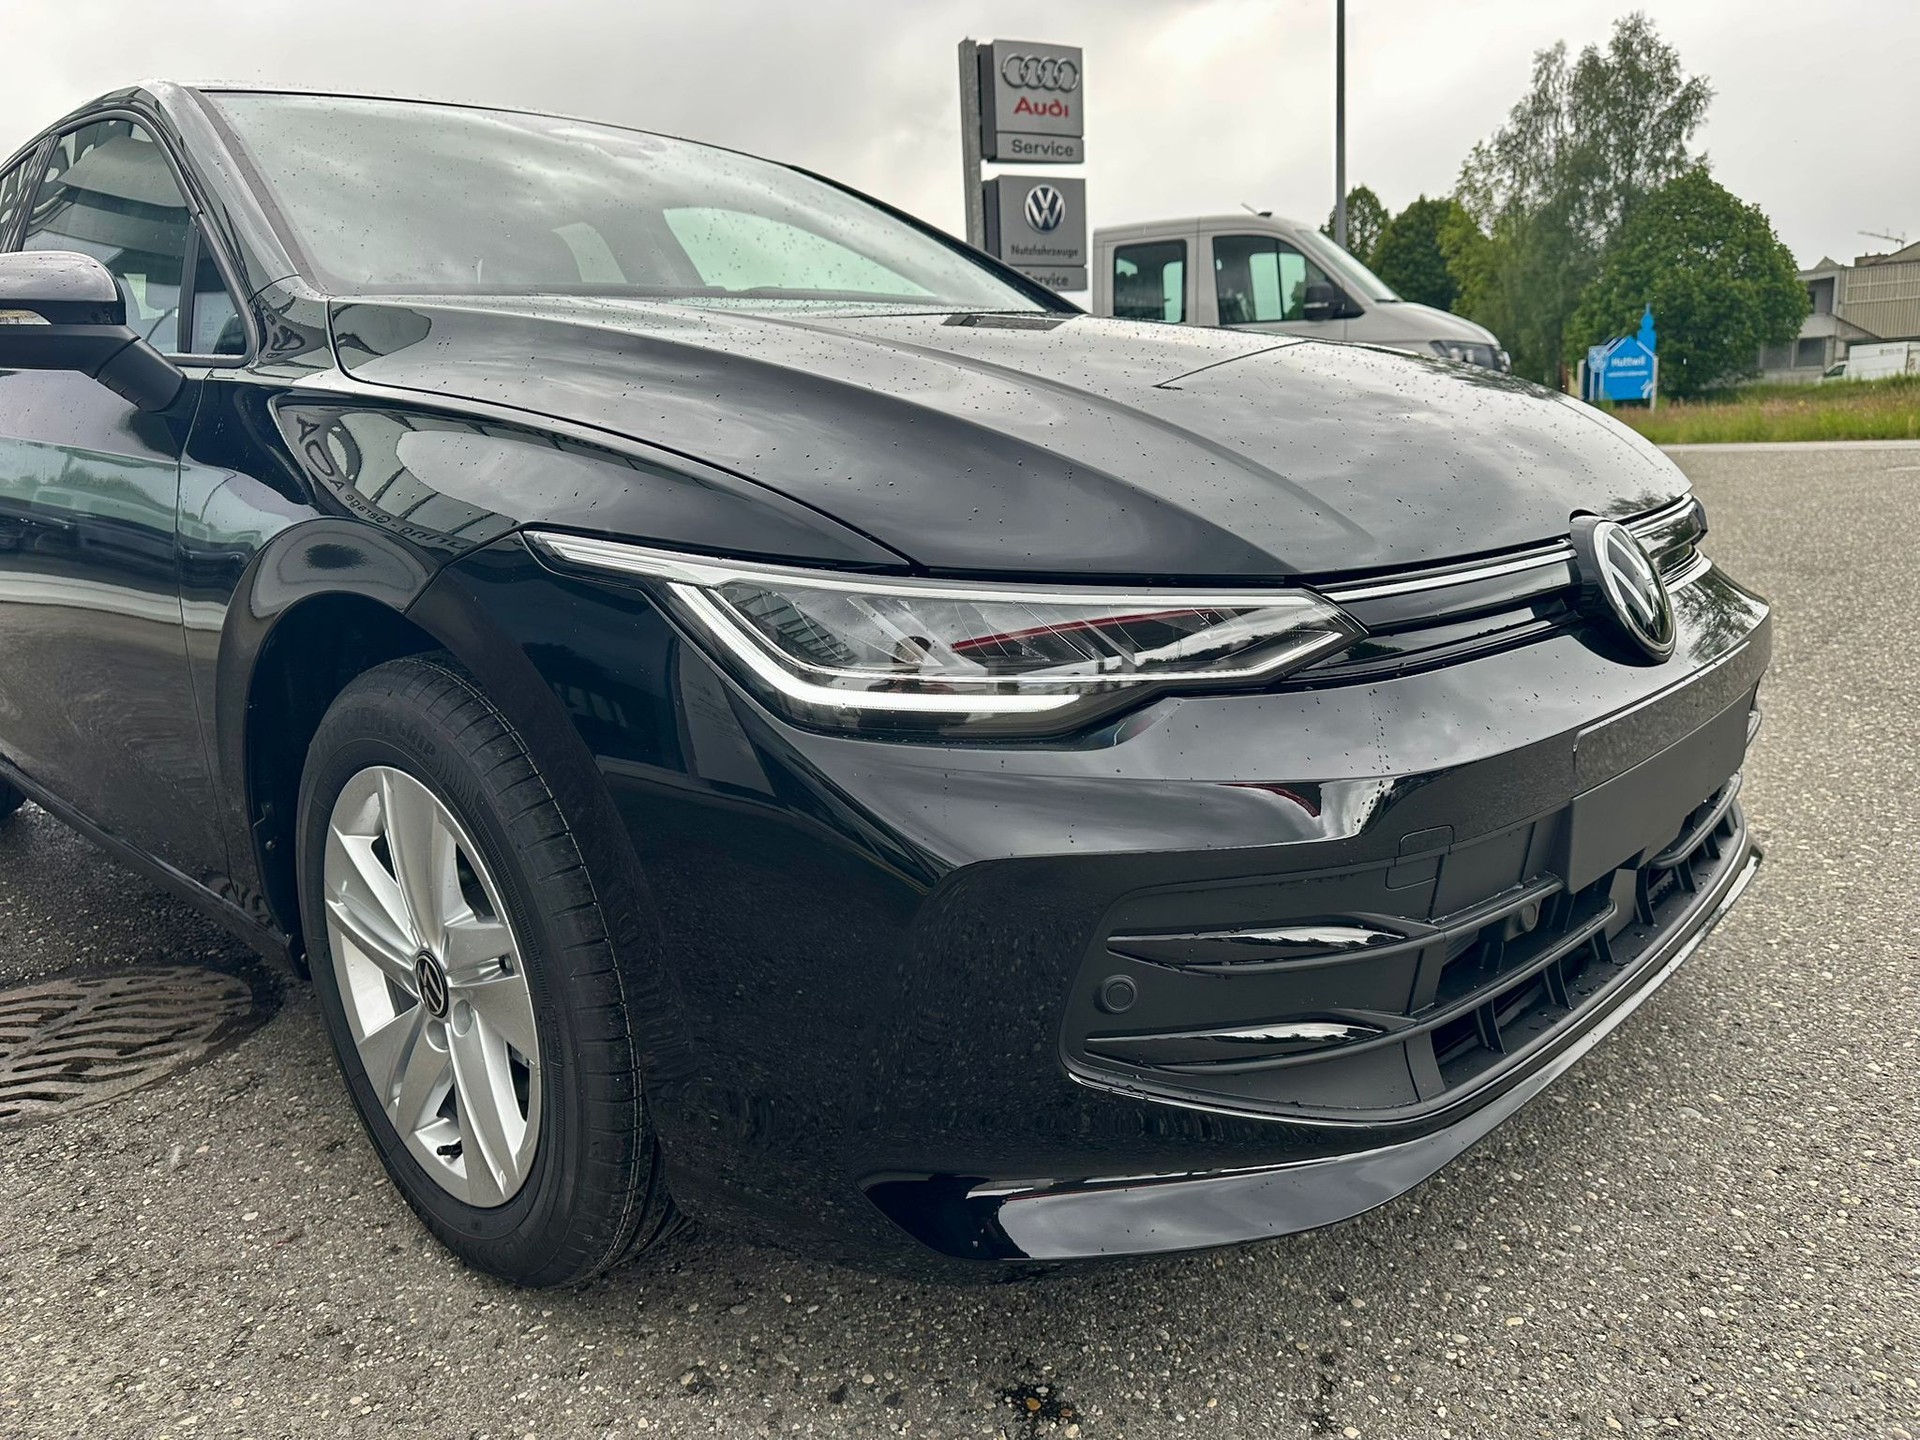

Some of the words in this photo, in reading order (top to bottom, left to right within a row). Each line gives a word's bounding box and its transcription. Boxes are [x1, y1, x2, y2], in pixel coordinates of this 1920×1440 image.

[1013, 96, 1069, 117] Audi
[1012, 139, 1074, 157] Service
[1011, 245, 1079, 259] Nutzfahrzeuge
[1025, 271, 1069, 287] rvice
